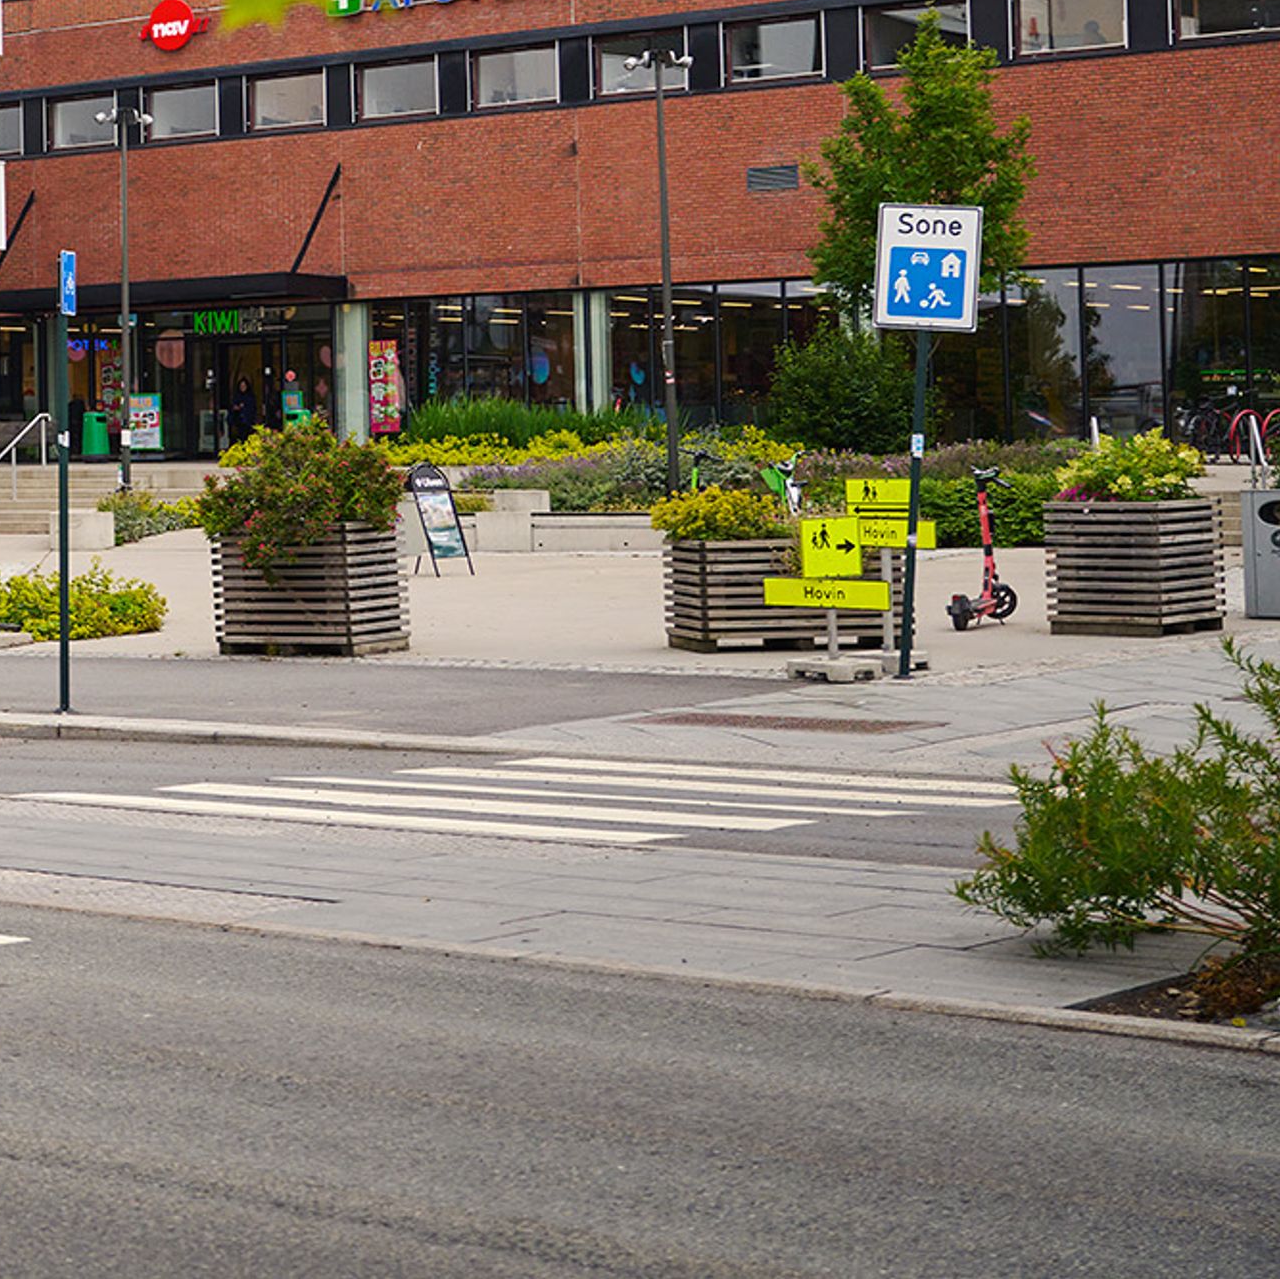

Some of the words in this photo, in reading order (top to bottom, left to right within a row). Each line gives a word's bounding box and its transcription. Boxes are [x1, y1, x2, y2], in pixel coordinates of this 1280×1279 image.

[898, 213, 962, 236] Sone
[194, 310, 238, 334] KIWI
[864, 527, 898, 540] Hovin
[804, 587, 846, 600] Hovin
